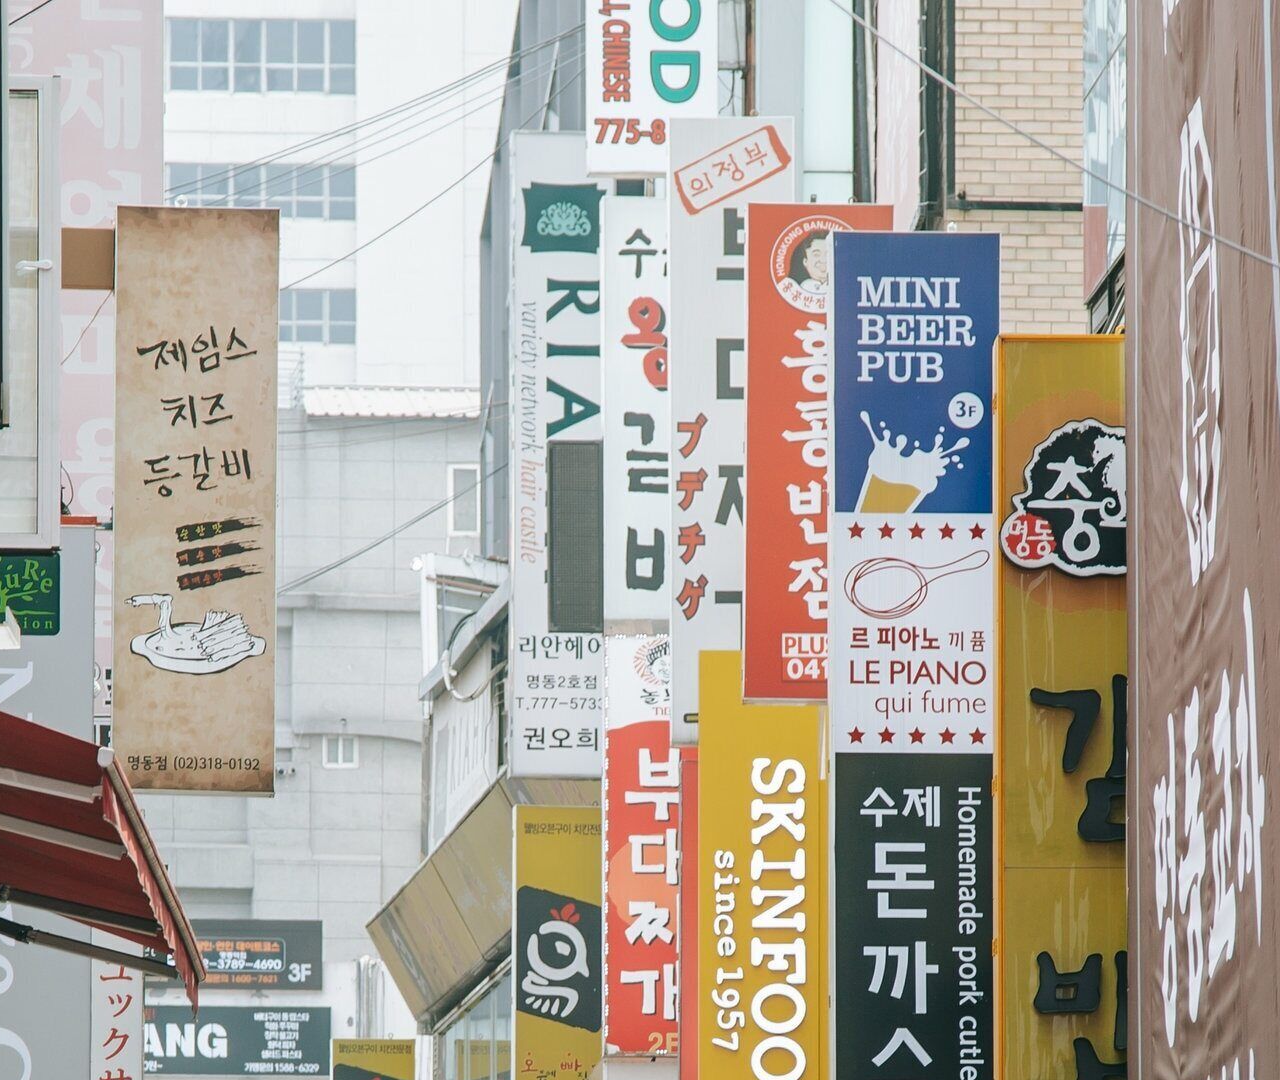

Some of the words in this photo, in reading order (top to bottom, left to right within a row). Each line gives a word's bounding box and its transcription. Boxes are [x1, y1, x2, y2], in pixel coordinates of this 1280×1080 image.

[602, 19, 631, 102] CHINESE
[595, 118, 667, 144] 775-8
[690, 142, 768, 197] 의정부
[857, 276, 961, 309] MINI
[857, 314, 976, 347] BEER
[136, 326, 258, 373] 제임스
[857, 351, 944, 384] PUB
[160, 393, 233, 428] 치즈
[521, 372, 544, 453] network
[955, 402, 977, 418] 3F
[143, 446, 251, 497] 등갈비
[521, 460, 544, 502] hair
[520, 507, 544, 564] castle
[1009, 518, 1055, 557] 명동
[850, 627, 870, 649] 르
[877, 626, 940, 651] 피아노
[949, 632, 964, 651] 끼
[970, 631, 986, 652] 품
[526, 675, 597, 690] 명동2호점
[786, 658, 827, 679] 041
[849, 660, 880, 685] LE
[890, 660, 987, 685] PIANO
[875, 691, 912, 720] qui
[921, 690, 987, 714] fume
[523, 728, 598, 752] 권오희
[127, 755, 168, 771] 명동점
[173, 755, 260, 772] (02)318-0192
[860, 786, 941, 828] 수제
[1154, 587, 1265, 1047] 명동교자
[957, 787, 984, 935] Homemade
[713, 849, 740, 957] since
[204, 959, 282, 971] 2-3789-4690
[287, 963, 312, 983] 3F
[952, 947, 984, 1005] pork
[712, 966, 745, 1052] 1957
